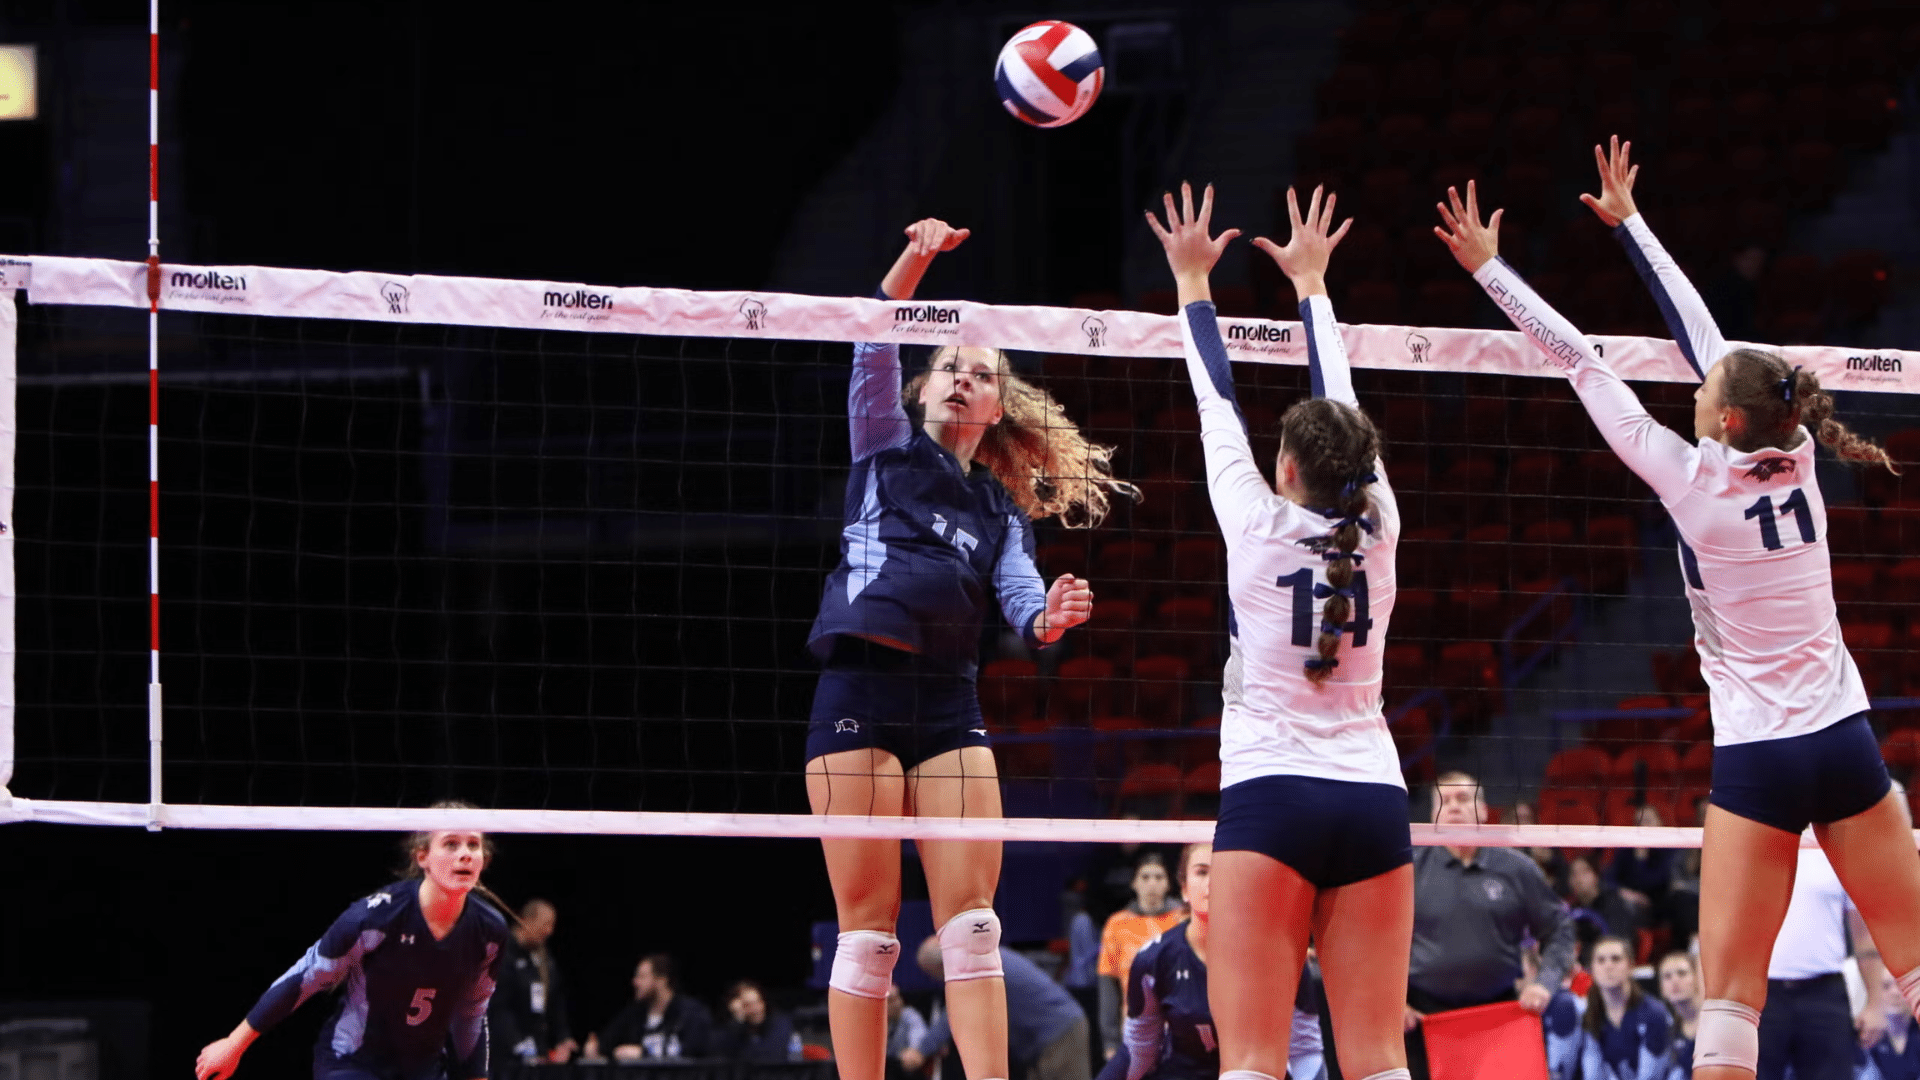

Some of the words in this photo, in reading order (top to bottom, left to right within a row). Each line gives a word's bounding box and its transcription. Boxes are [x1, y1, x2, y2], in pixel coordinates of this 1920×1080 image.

[171, 271, 246, 290] molten
[544, 290, 613, 310] molten
[895, 305, 960, 324] molten
[1487, 278, 1583, 369] HAWKS
[1228, 322, 1291, 343] molten
[1846, 355, 1902, 373] molten
[1744, 487, 1817, 552] 11
[1276, 567, 1373, 648] 14
[405, 987, 438, 1027] 5
